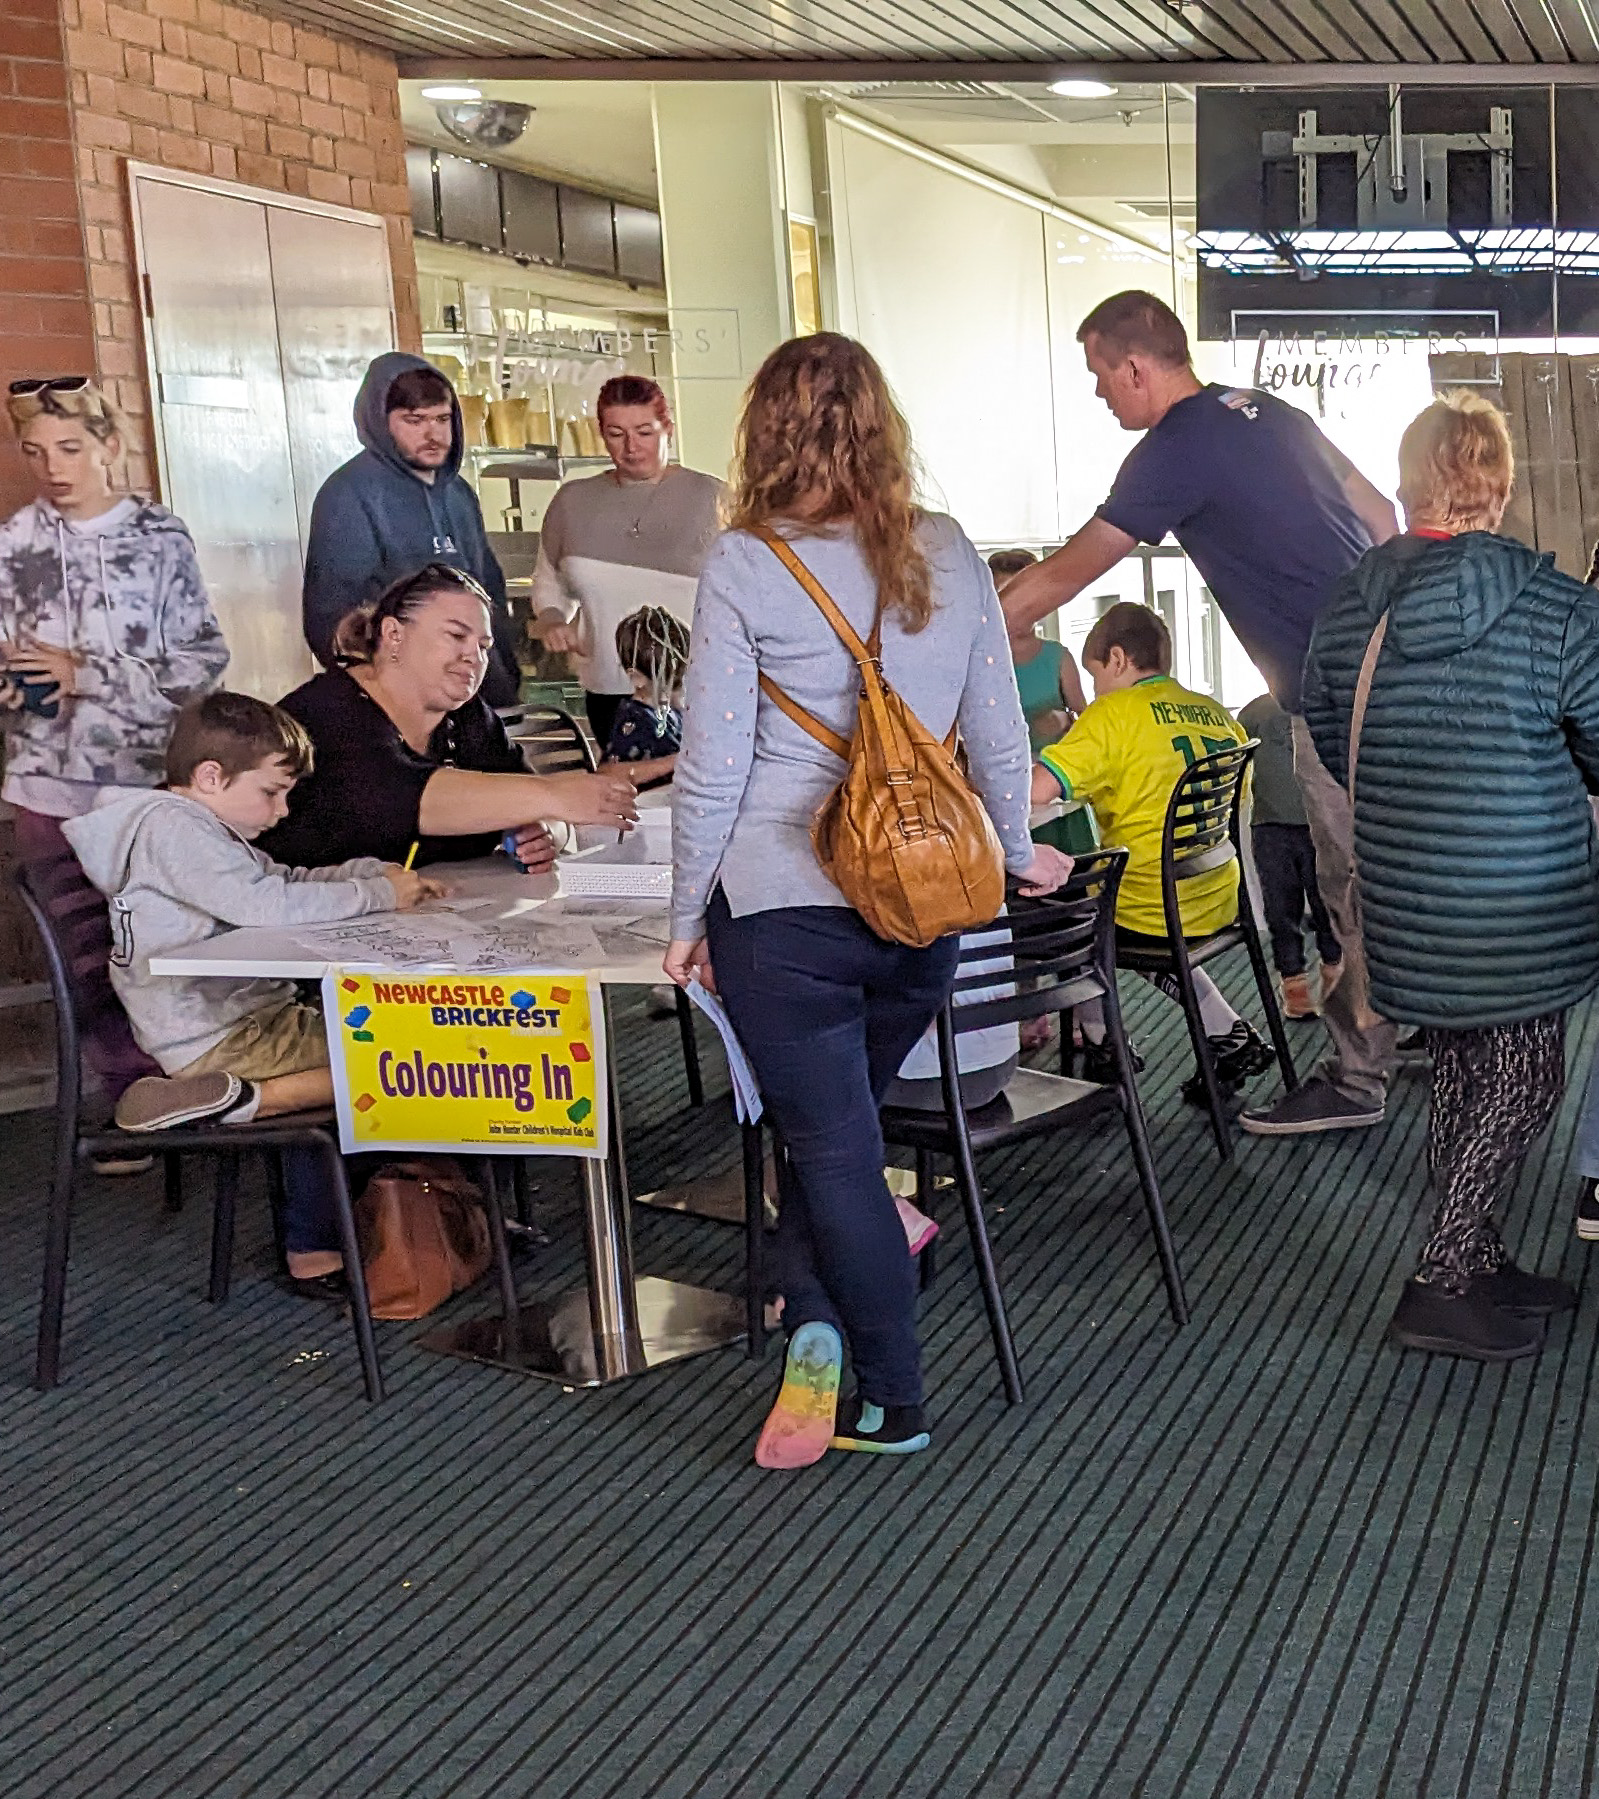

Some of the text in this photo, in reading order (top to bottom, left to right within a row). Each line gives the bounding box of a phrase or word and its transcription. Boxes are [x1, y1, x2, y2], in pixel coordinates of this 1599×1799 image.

[1277, 330, 1487, 356] MEMBERS'
[1150, 701, 1216, 727] NEYMAR
[379, 1046, 574, 1112] Colouring In
